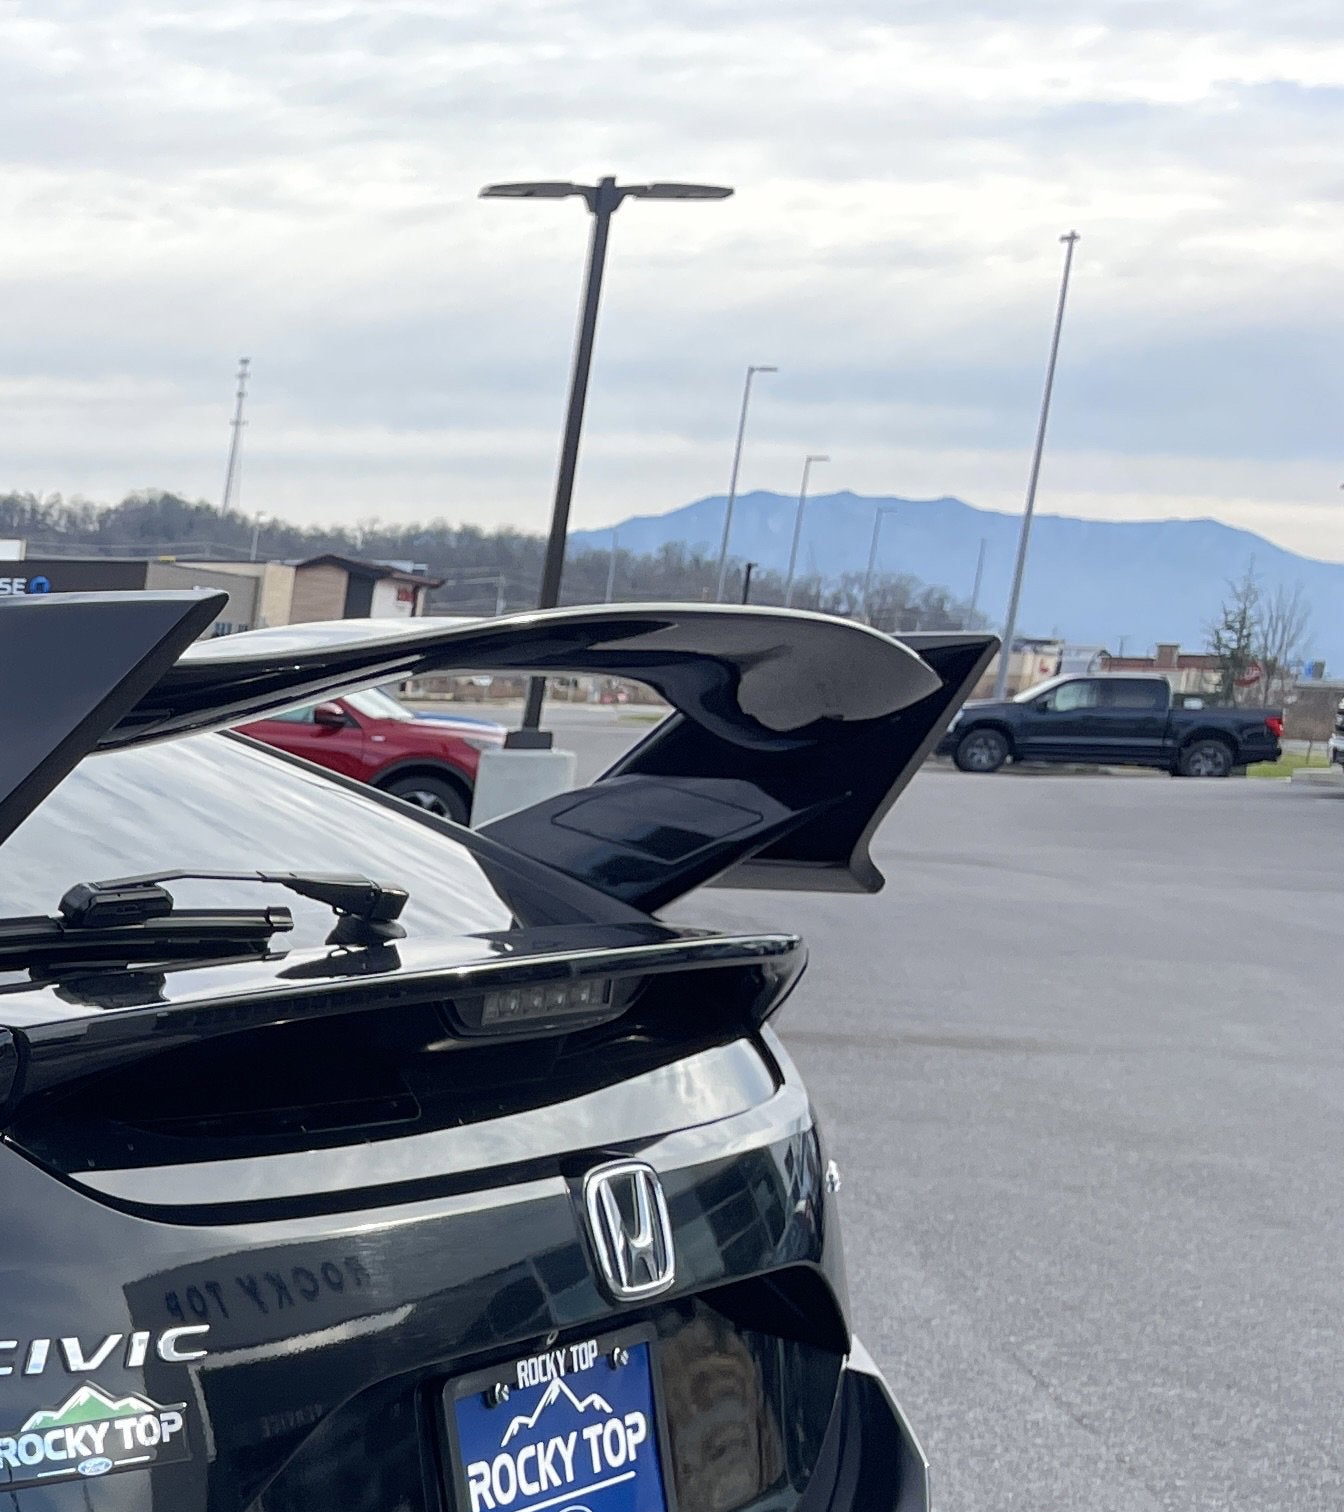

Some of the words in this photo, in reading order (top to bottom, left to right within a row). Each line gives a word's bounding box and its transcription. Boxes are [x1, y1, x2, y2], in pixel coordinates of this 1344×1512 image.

[516, 1348, 566, 1389] ROCKY
[570, 1339, 598, 1373] TOP
[114, 1411, 183, 1450] TOP
[583, 1411, 647, 1474] TOP
